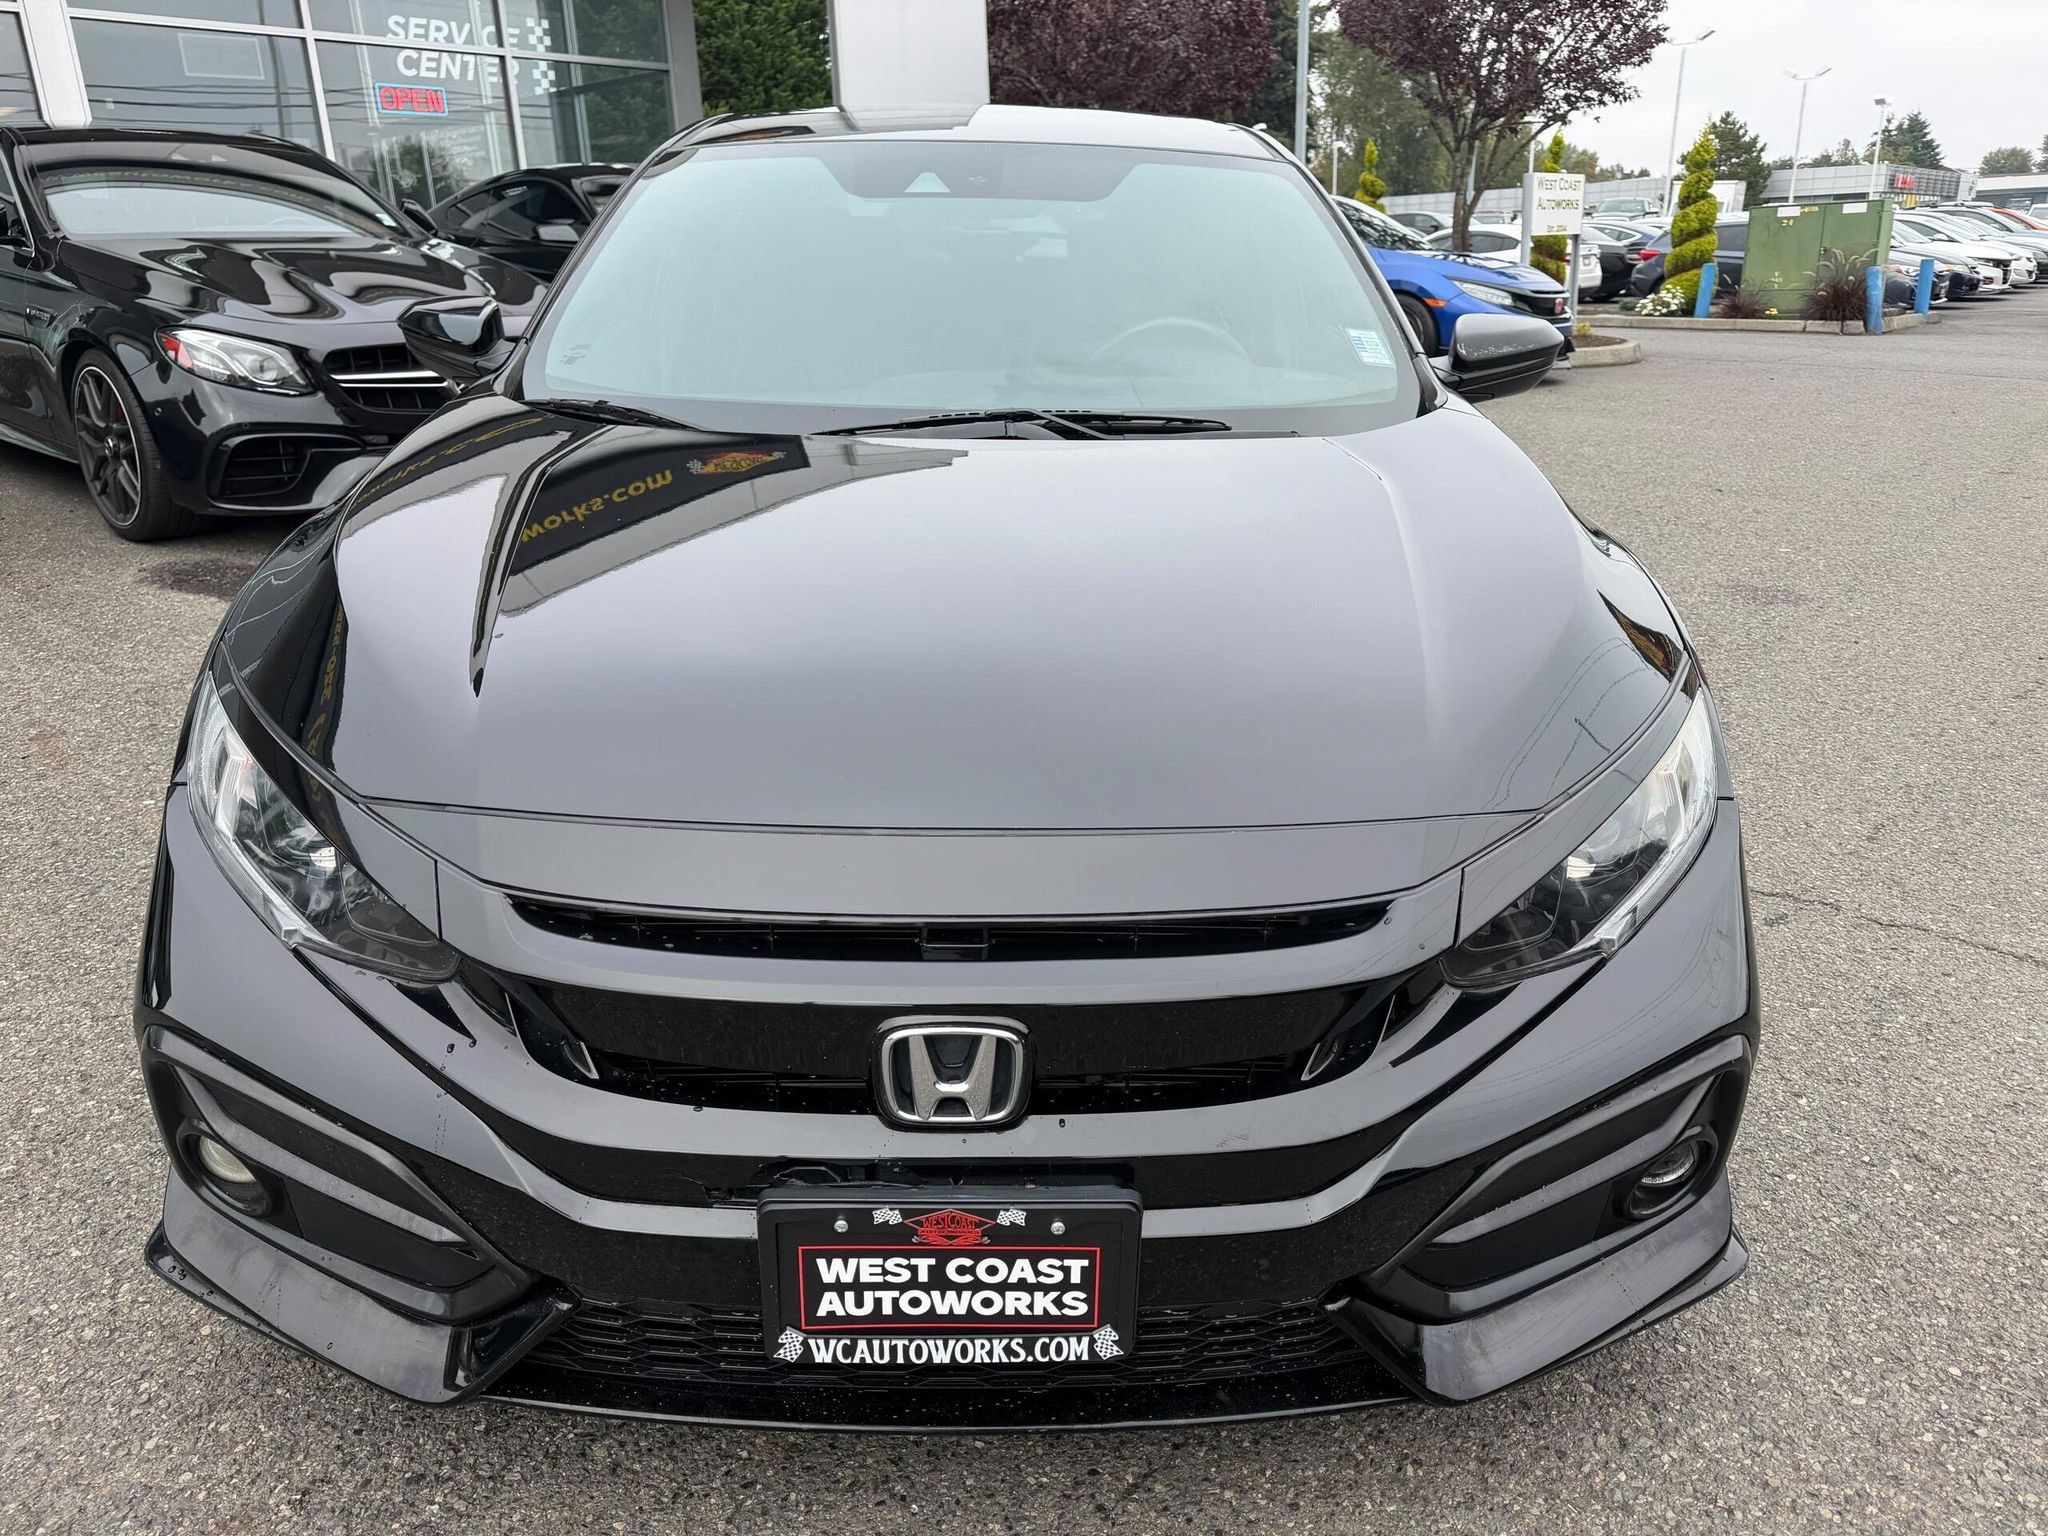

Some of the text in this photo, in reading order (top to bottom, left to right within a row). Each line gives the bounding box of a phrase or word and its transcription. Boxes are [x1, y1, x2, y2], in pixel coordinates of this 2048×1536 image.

[386, 15, 520, 50] SERVCE
[379, 86, 445, 113] OPEN
[1536, 176, 1582, 190] WEST COAST
[1536, 197, 1580, 210] AUTOWORKS
[922, 1213, 980, 1229] WEST COAST
[816, 1257, 1089, 1284] WEST COAST
[816, 1290, 1089, 1317] AUTOWORKS
[808, 1336, 1090, 1364] WCAUTOWORKS.COM
